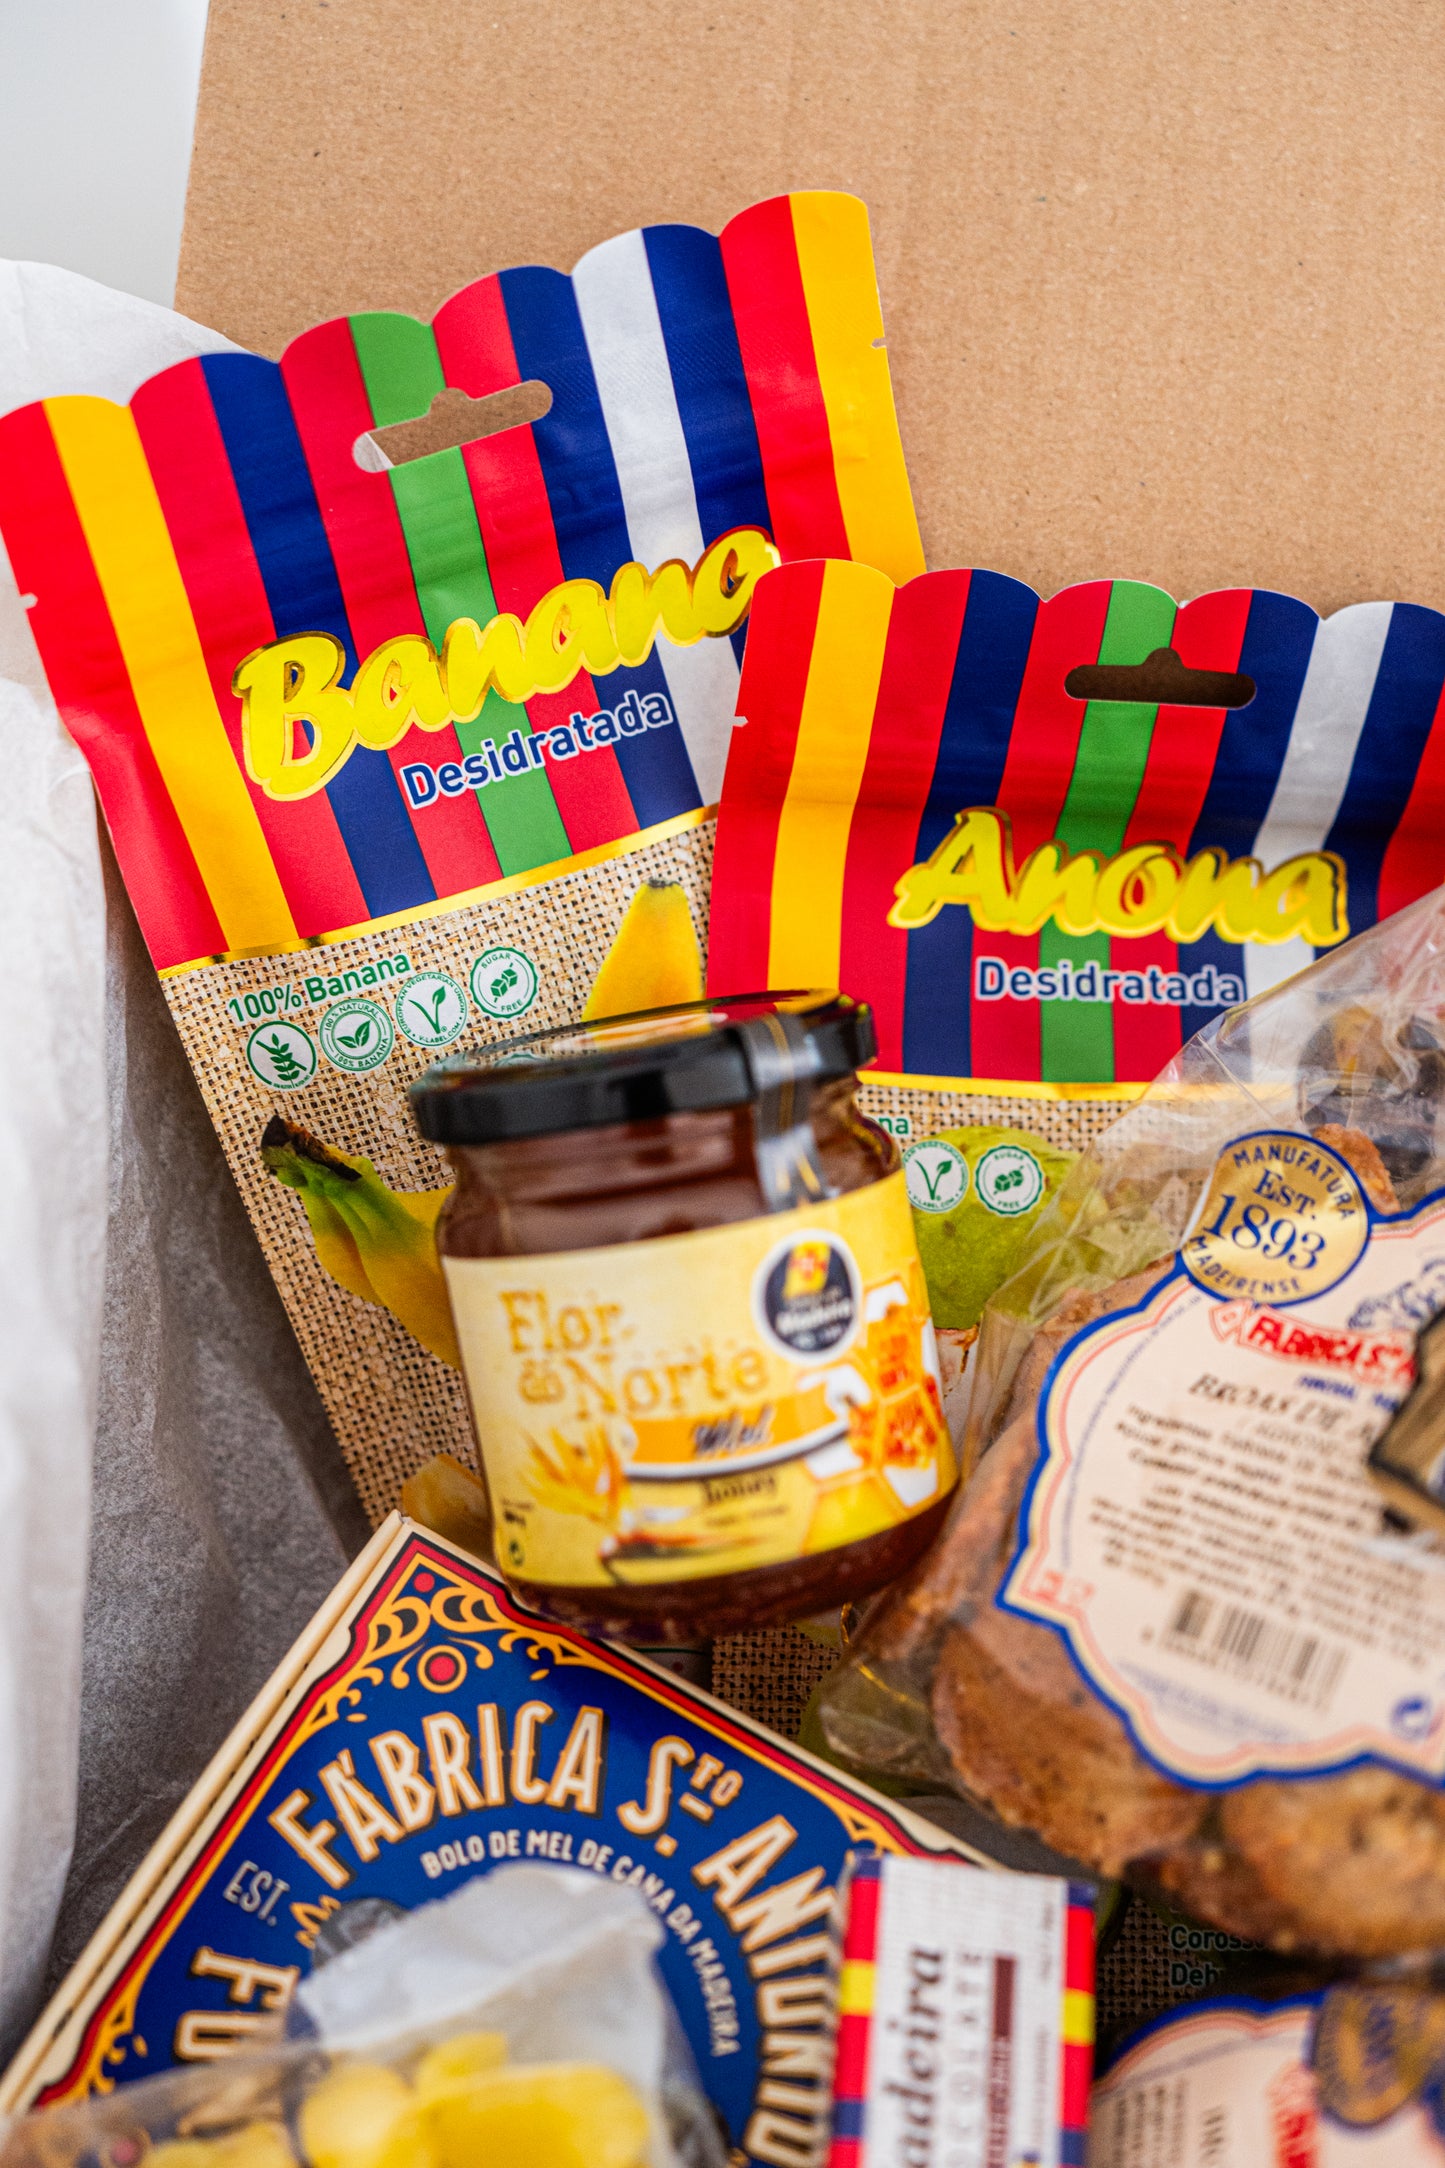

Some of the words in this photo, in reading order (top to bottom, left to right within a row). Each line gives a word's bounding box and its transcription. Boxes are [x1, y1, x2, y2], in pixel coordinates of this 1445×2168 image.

[231, 525, 782, 802] Banana
[400, 692, 675, 809] Desidratada
[886, 806, 1350, 947] Anona
[228, 984, 302, 1023] 100%
[304, 953, 411, 1003] Banana
[481, 953, 511, 969] SUGAR
[975, 955, 1247, 1005] Desidratada
[339, 1002, 379, 1018] NATURAL
[501, 999, 523, 1012] FREE
[358, 1037, 389, 1067] BANANA
[994, 1150, 1024, 1161] SUGAR
[1233, 1145, 1355, 1219] MANUFATURA
[997, 1200, 1020, 1209] FREE
[1202, 1193, 1326, 1271] 1893
[267, 1700, 603, 1889] FÁBRICA
[222, 1859, 291, 1927] EST.
[420, 1834, 485, 1879] BOLO
[488, 1829, 521, 1857] DE
[525, 1829, 573, 1861] MEL
[577, 1838, 614, 1873] DE
[611, 1855, 676, 1914] CANA
[666, 1903, 702, 1945] DA
[686, 1937, 741, 2057] MADEIRA
[884, 1945, 942, 2168] adeira
